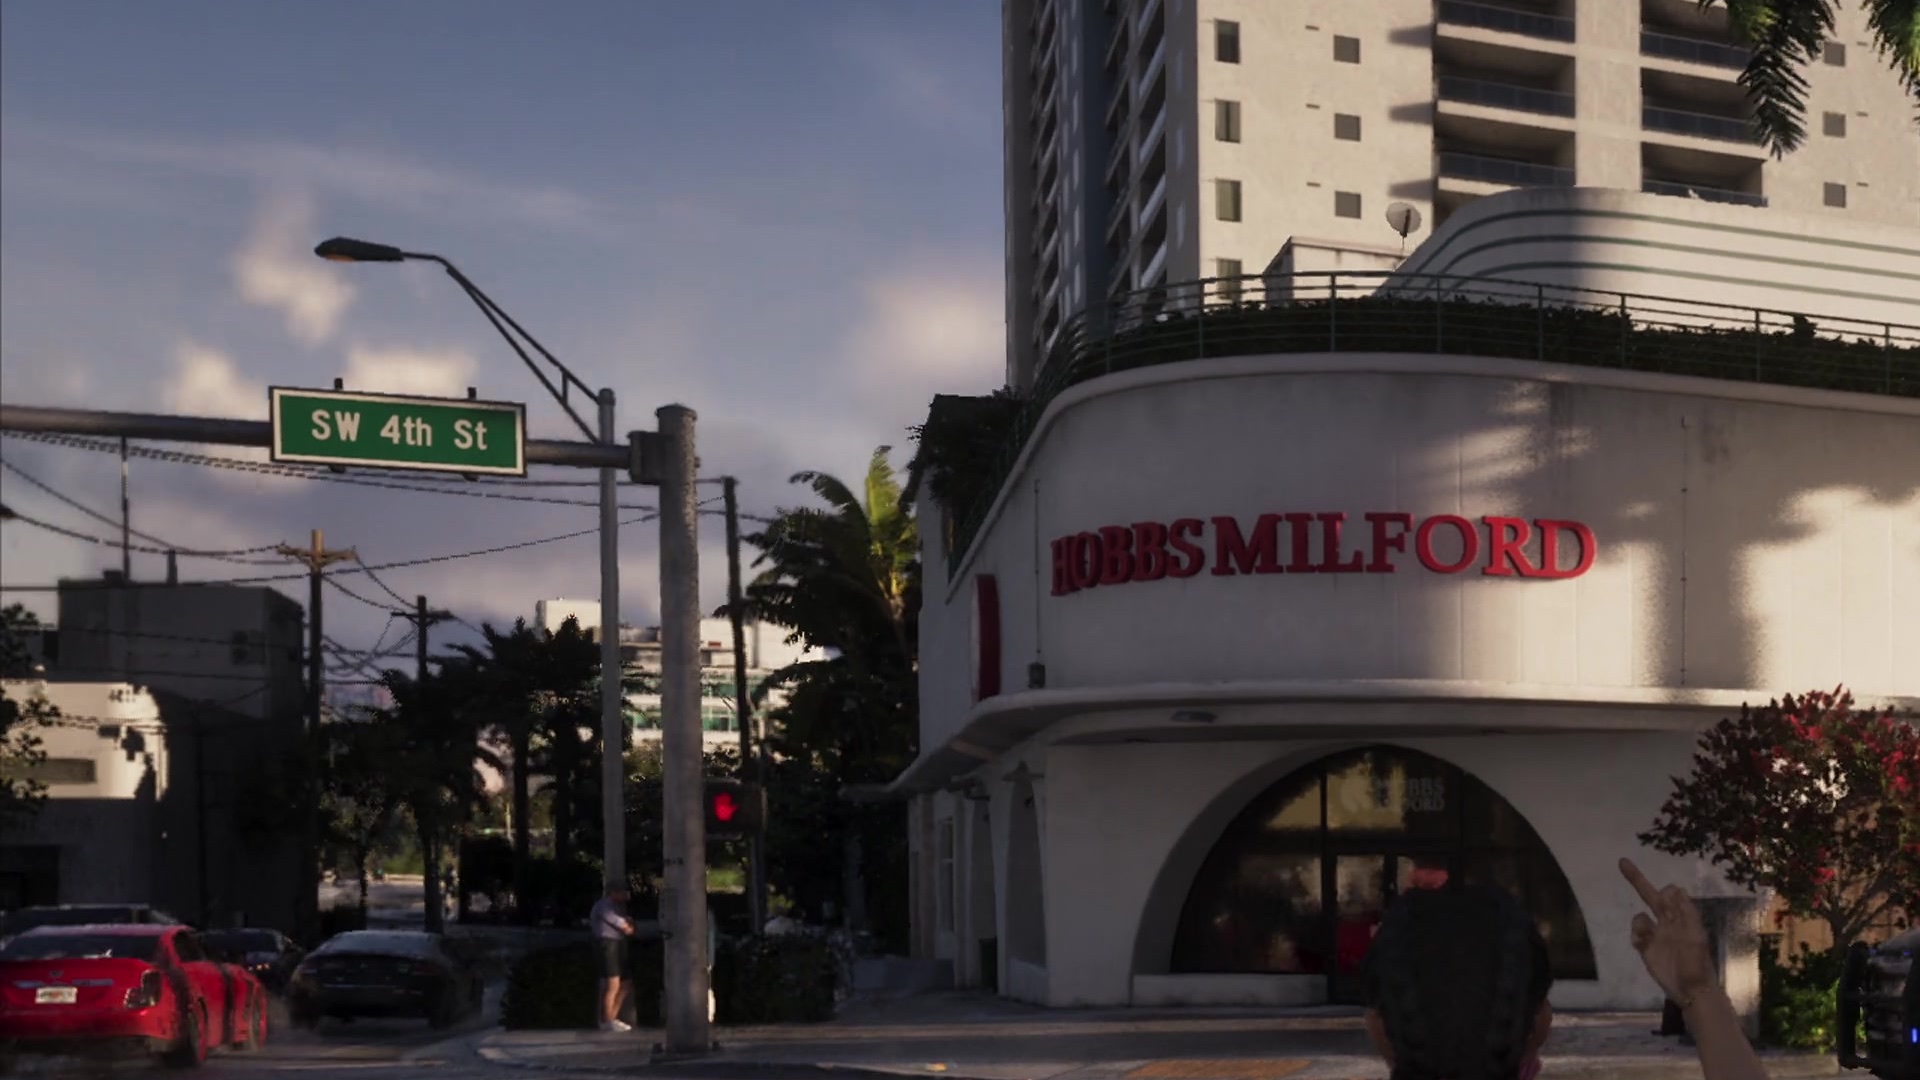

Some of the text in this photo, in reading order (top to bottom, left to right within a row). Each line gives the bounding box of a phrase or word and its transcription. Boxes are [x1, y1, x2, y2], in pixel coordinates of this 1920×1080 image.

[311, 408, 488, 451] SW 4th St
